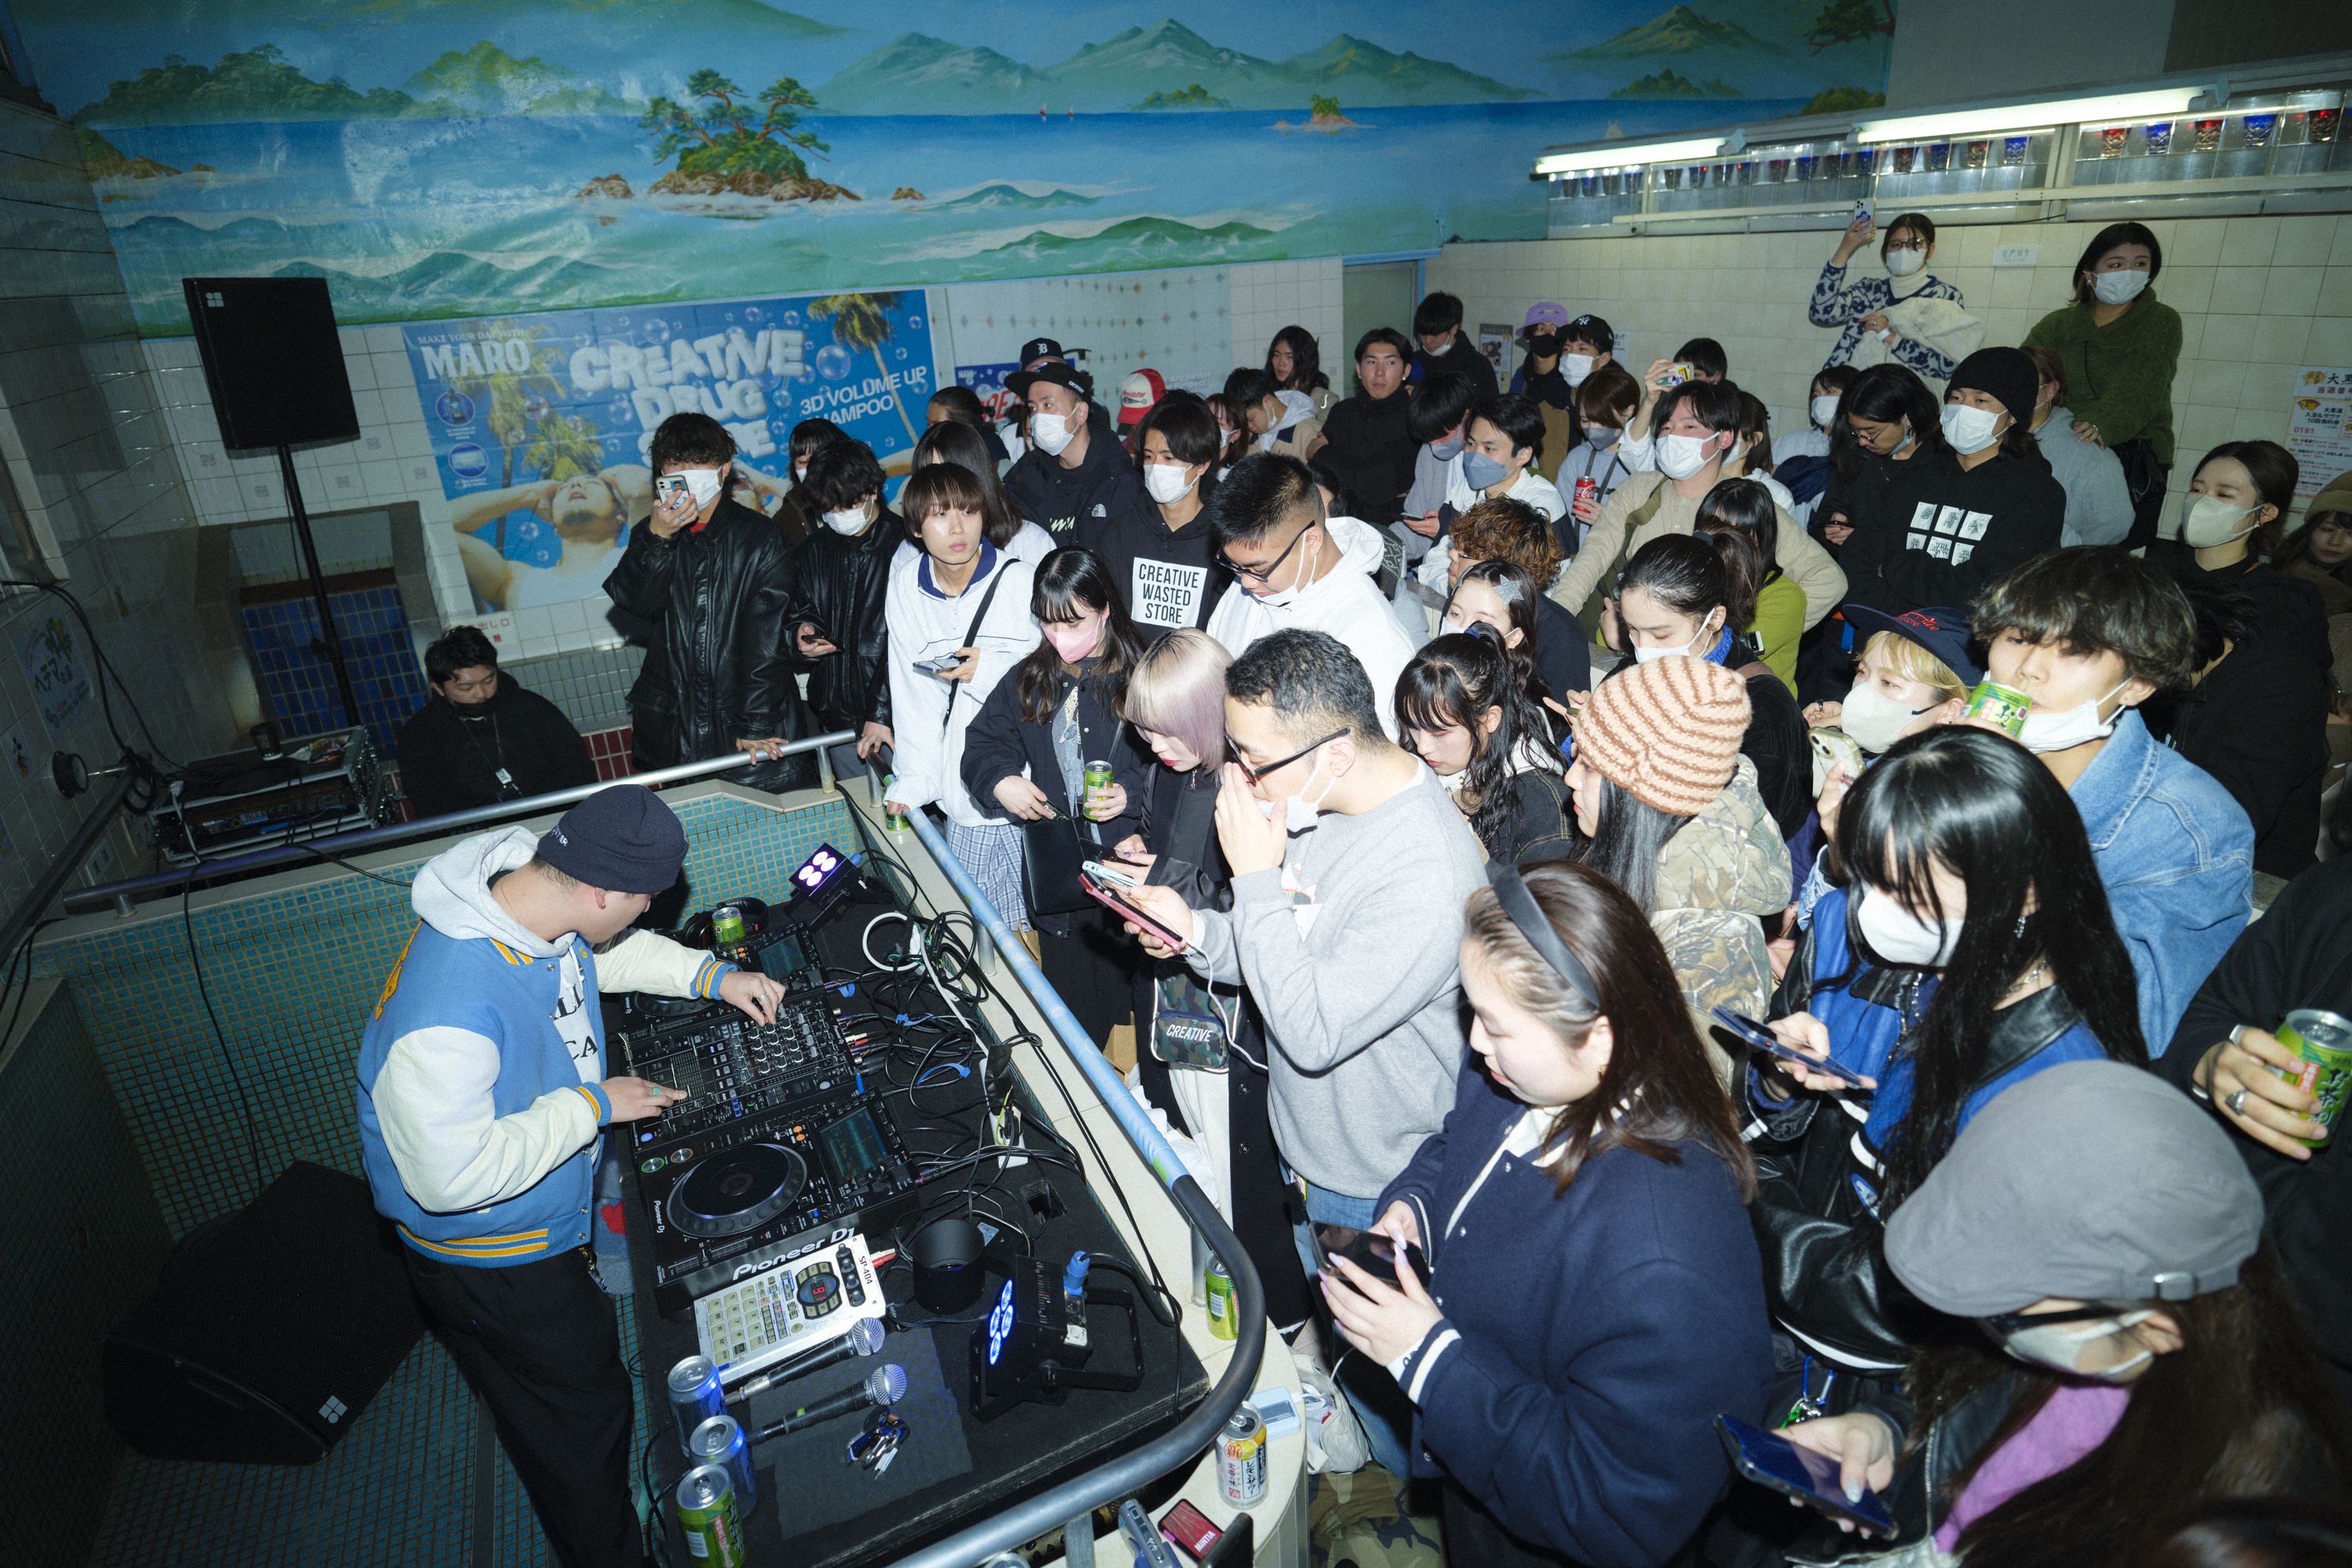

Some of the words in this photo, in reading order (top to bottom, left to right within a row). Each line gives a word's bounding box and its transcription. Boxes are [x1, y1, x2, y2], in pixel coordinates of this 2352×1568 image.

[417, 334, 448, 345] MAKE
[449, 332, 475, 342] YOUR
[477, 330, 497, 339] DAY
[498, 328, 525, 337] WITH
[420, 337, 531, 380] MARO
[569, 329, 806, 393] CREATIVE
[800, 394, 825, 416] 3D
[826, 372, 902, 407] VOLUME
[903, 365, 927, 385] UP
[630, 379, 768, 432] DRUG
[807, 394, 894, 425] AMPOO
[1138, 563, 1200, 589] CREATIVE
[1142, 583, 1192, 606] WASTED
[1145, 602, 1183, 624] STORE
[1166, 1024, 1214, 1043] CREATIVE
[654, 1200, 662, 1225] Pioneer
[732, 1238, 826, 1281] Pioneer
[858, 1255, 873, 1285] SP-404
[1227, 1443, 1241, 1460] 新
[1228, 1462, 1238, 1487] 定番の味
[1245, 1461, 1257, 1496] レモンサワー
[1194, 1530, 1216, 1552] MINTIA
